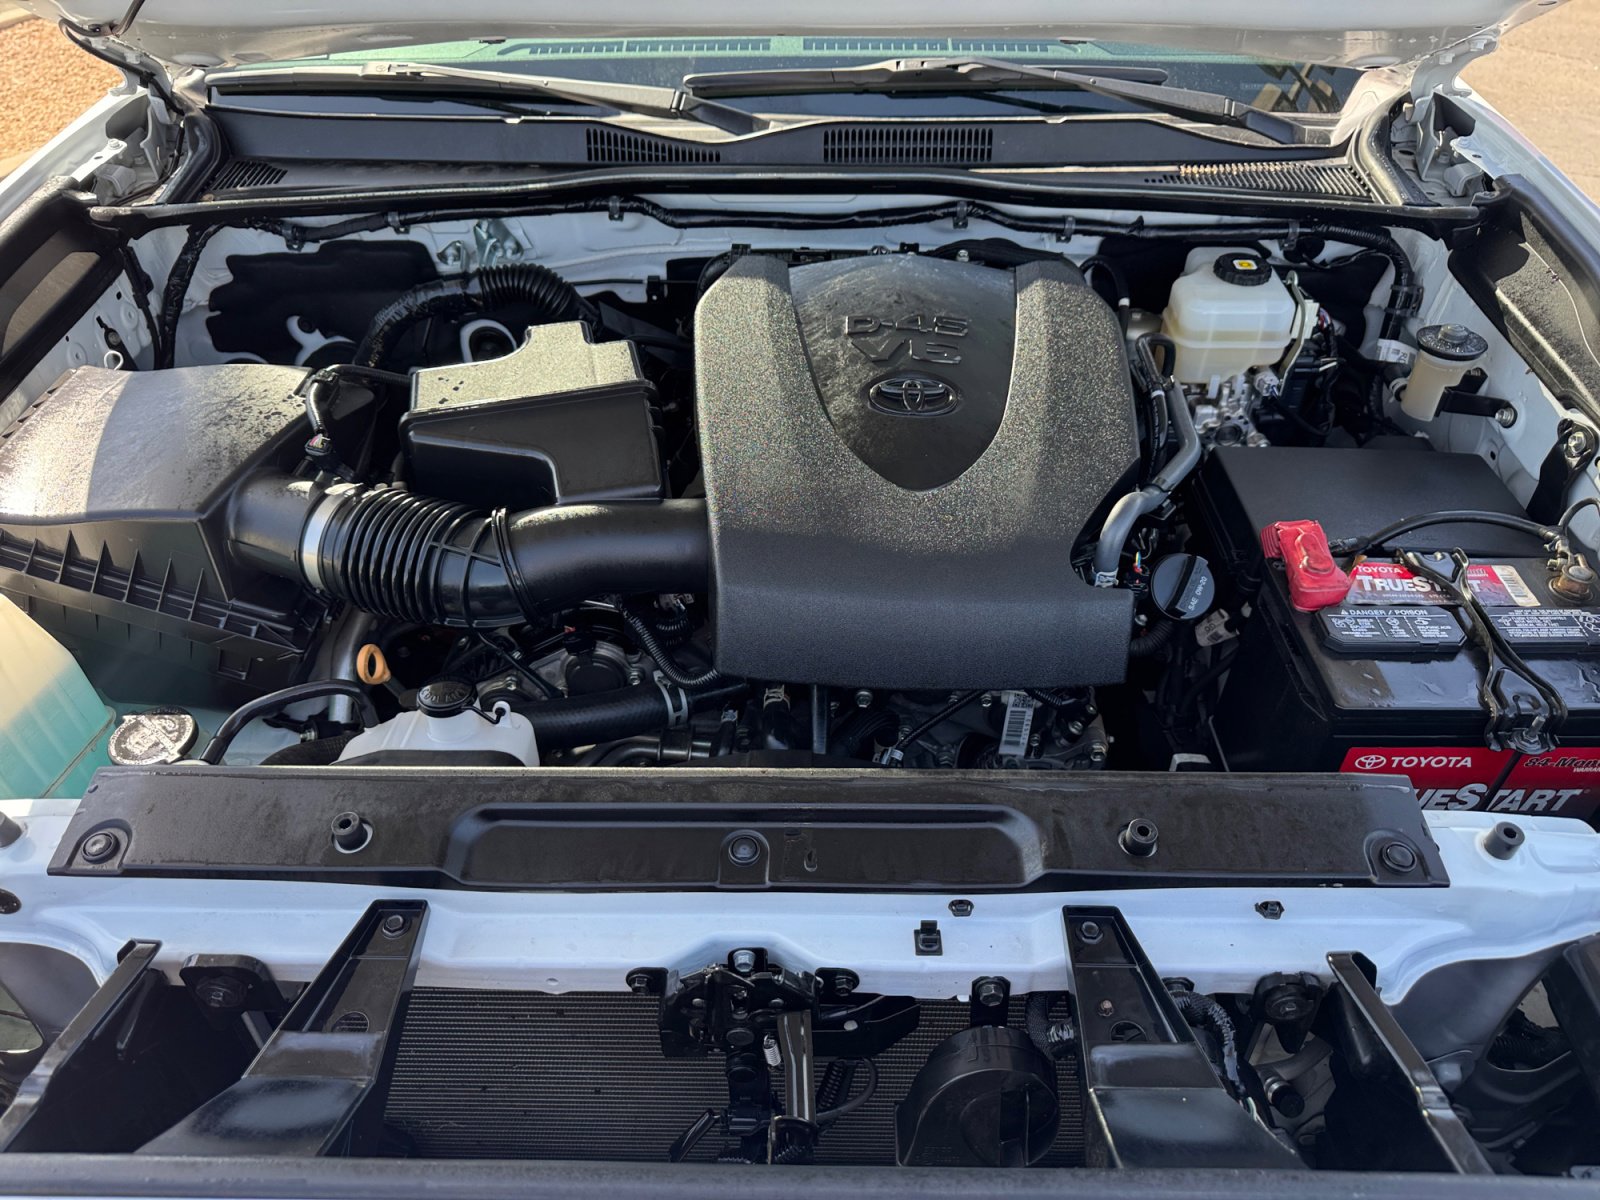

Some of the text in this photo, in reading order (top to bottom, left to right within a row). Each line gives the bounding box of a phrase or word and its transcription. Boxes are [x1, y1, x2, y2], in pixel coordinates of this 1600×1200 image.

[846, 314, 968, 337] D-4S
[850, 338, 962, 364] V6
[1357, 565, 1403, 574] TOYOTA
[1188, 575, 1208, 612] SAE 0W-20
[1391, 756, 1473, 768] TOYOTA
[1413, 783, 1584, 812] UESTART
